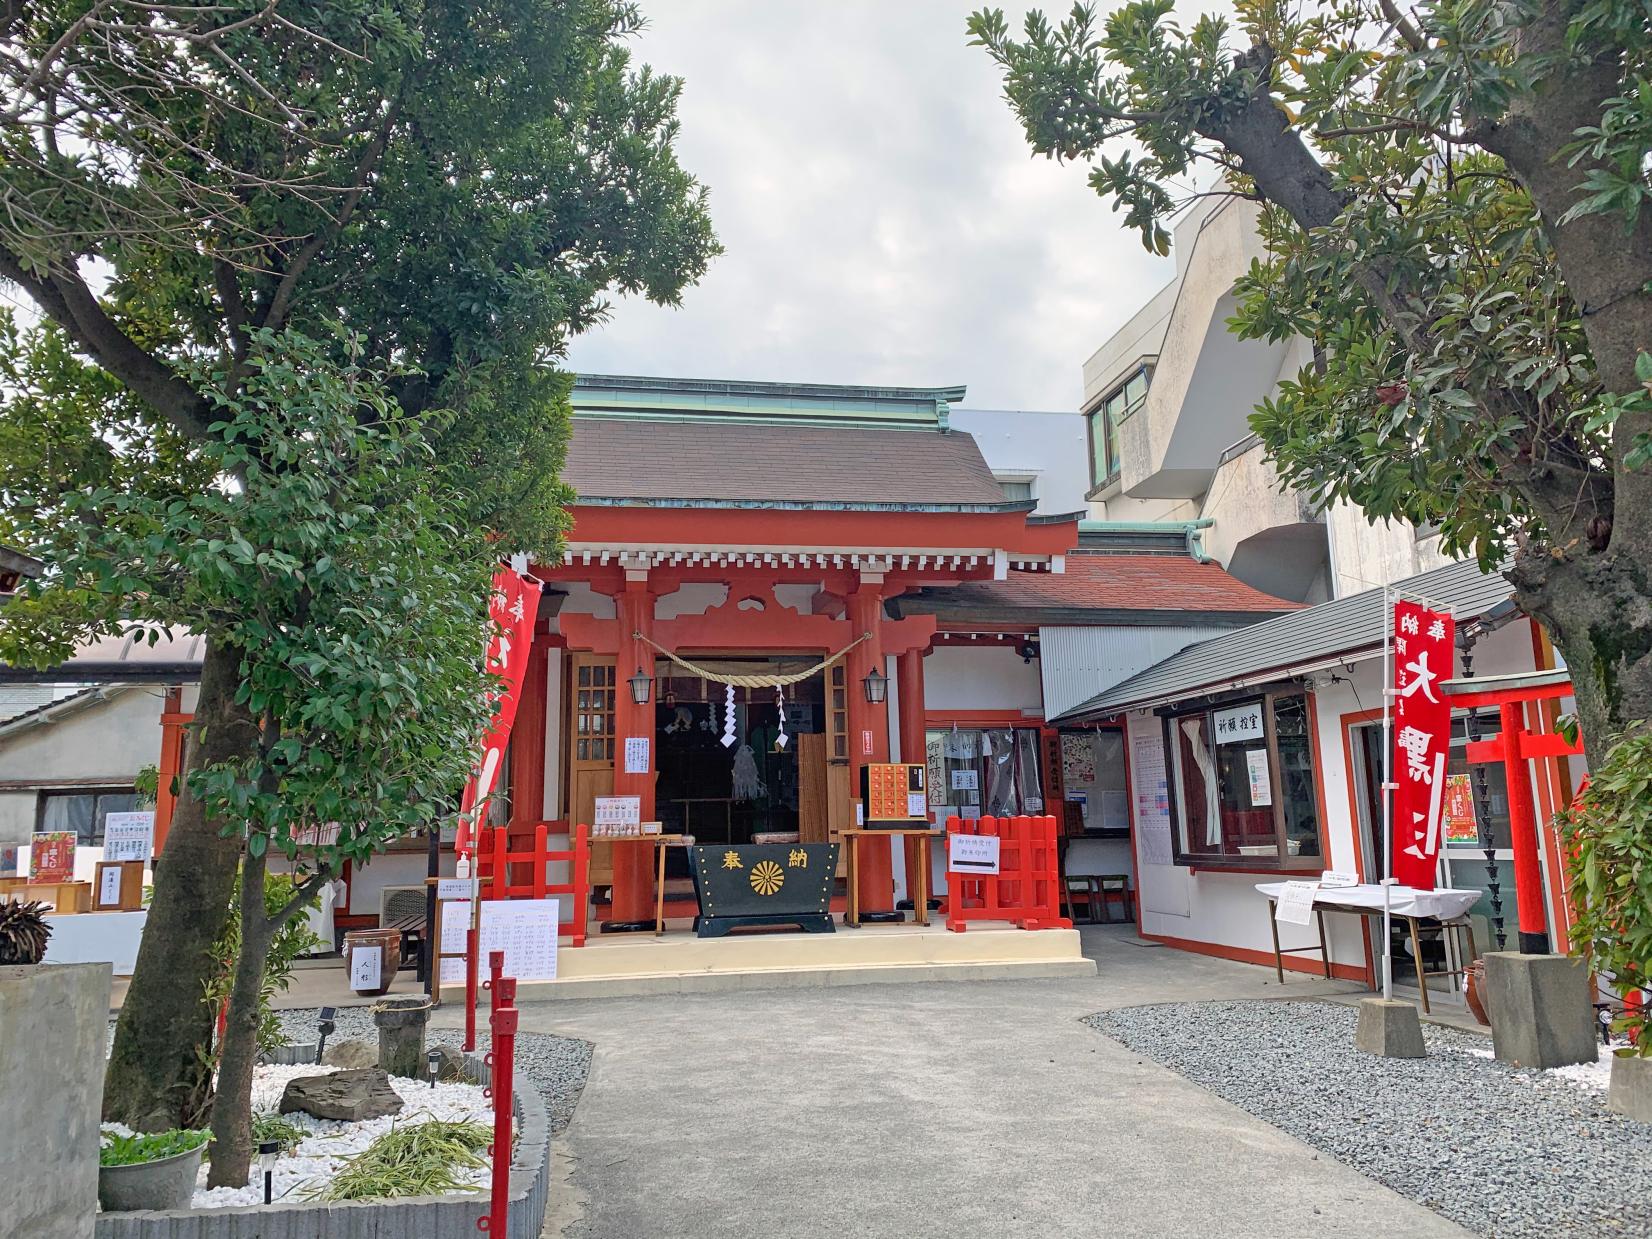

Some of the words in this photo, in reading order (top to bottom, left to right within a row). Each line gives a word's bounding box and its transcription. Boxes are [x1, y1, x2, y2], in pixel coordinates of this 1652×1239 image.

[927, 740, 944, 805] 御祈願受付
[722, 850, 744, 870] 奉
[788, 849, 808, 868] 納
